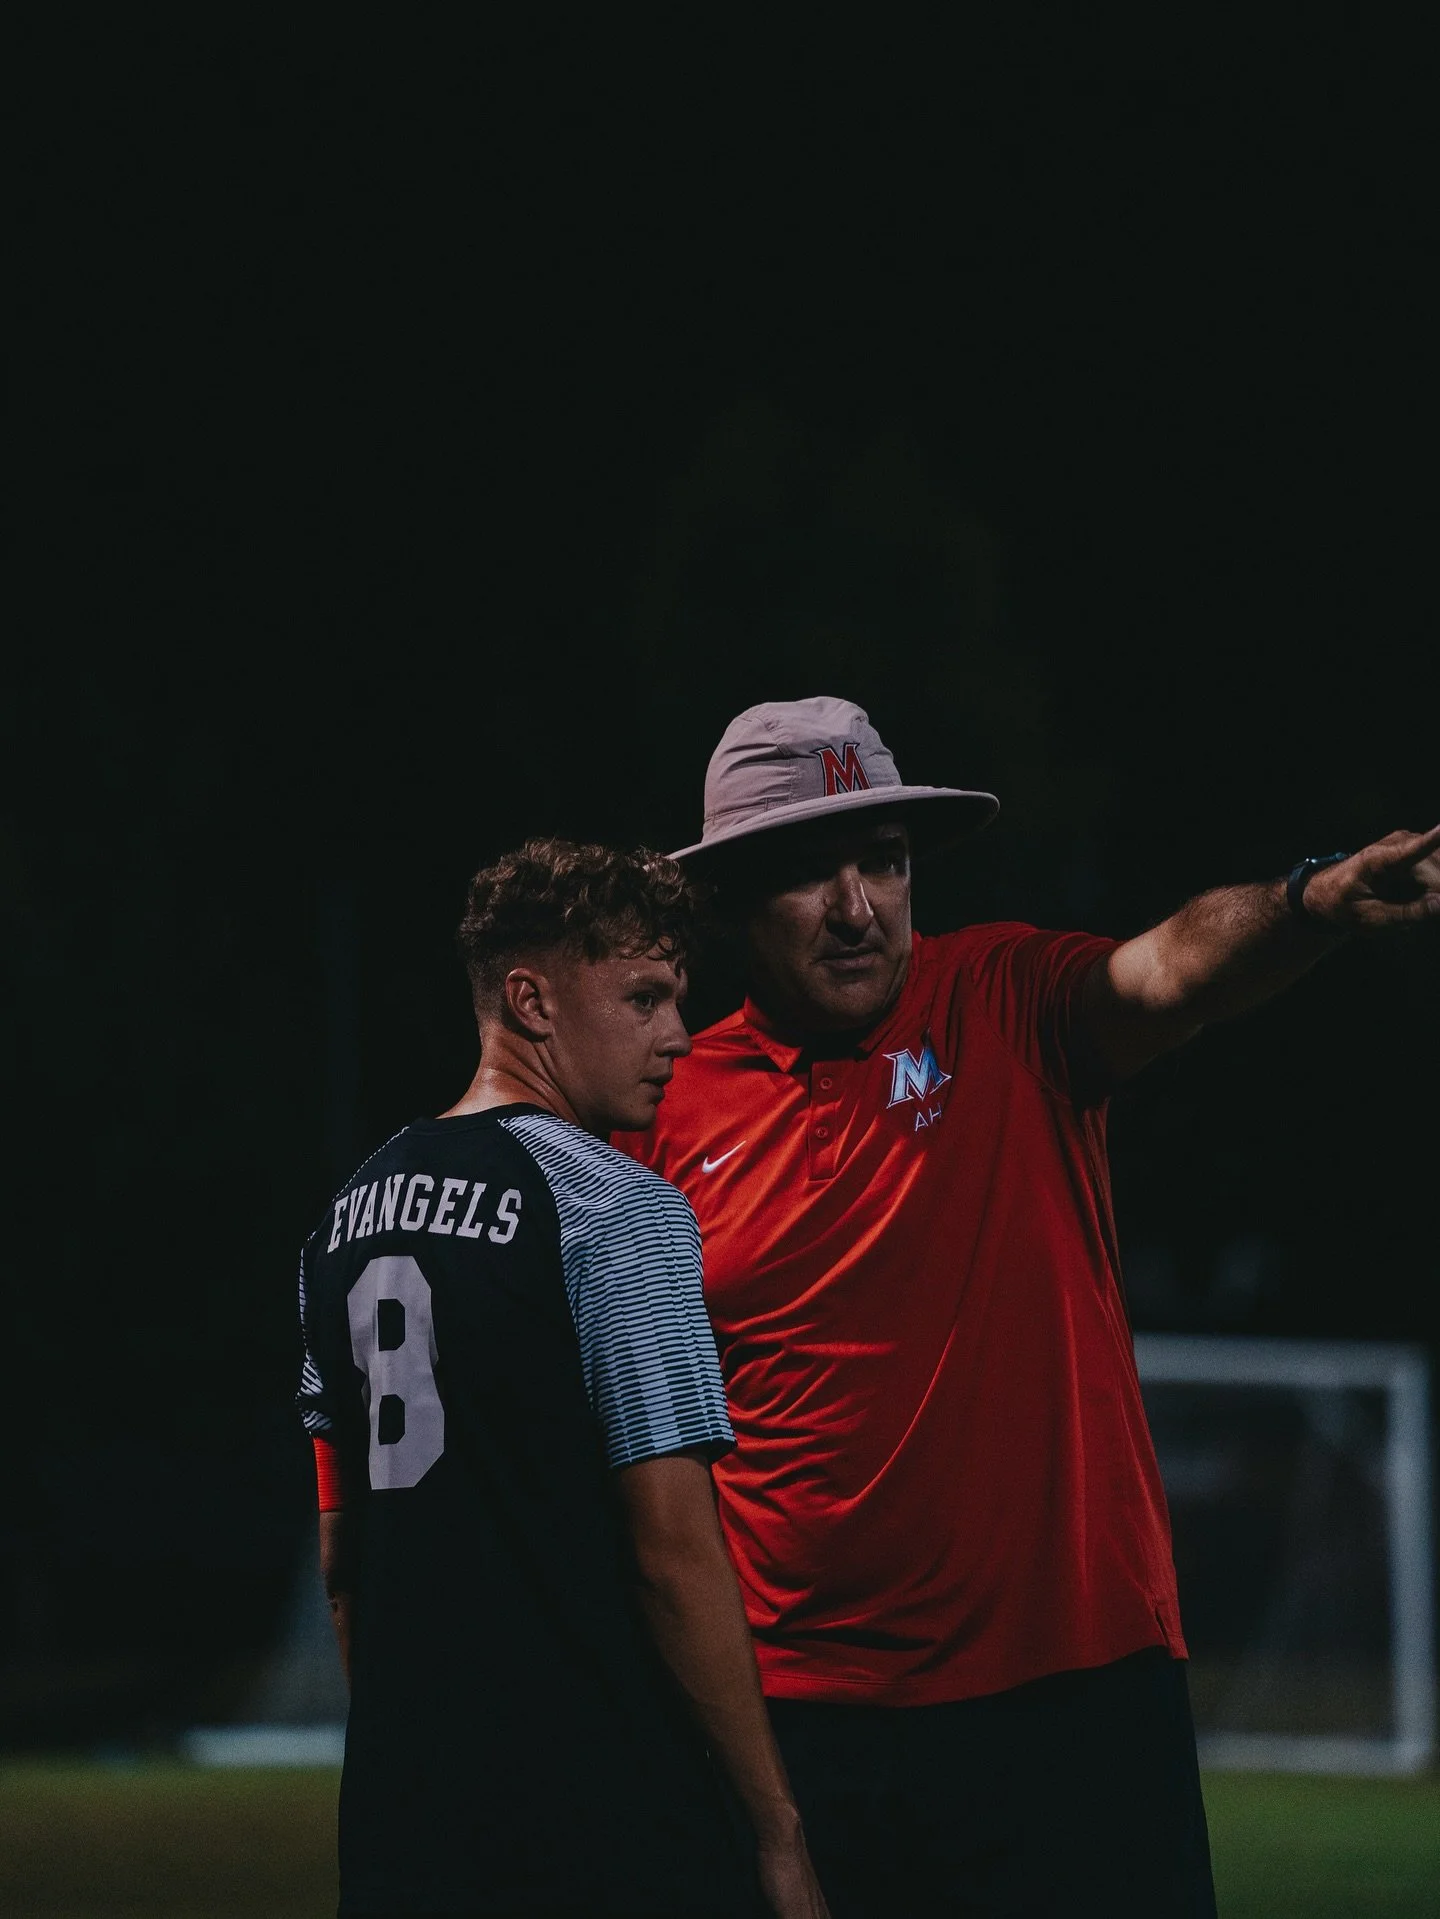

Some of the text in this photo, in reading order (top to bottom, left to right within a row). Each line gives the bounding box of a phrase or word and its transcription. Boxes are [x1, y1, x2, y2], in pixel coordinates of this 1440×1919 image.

[809, 742, 872, 797] M
[881, 1046, 953, 1109] M
[327, 1173, 522, 1254] EVANGELS
[347, 1255, 445, 1490] 8
